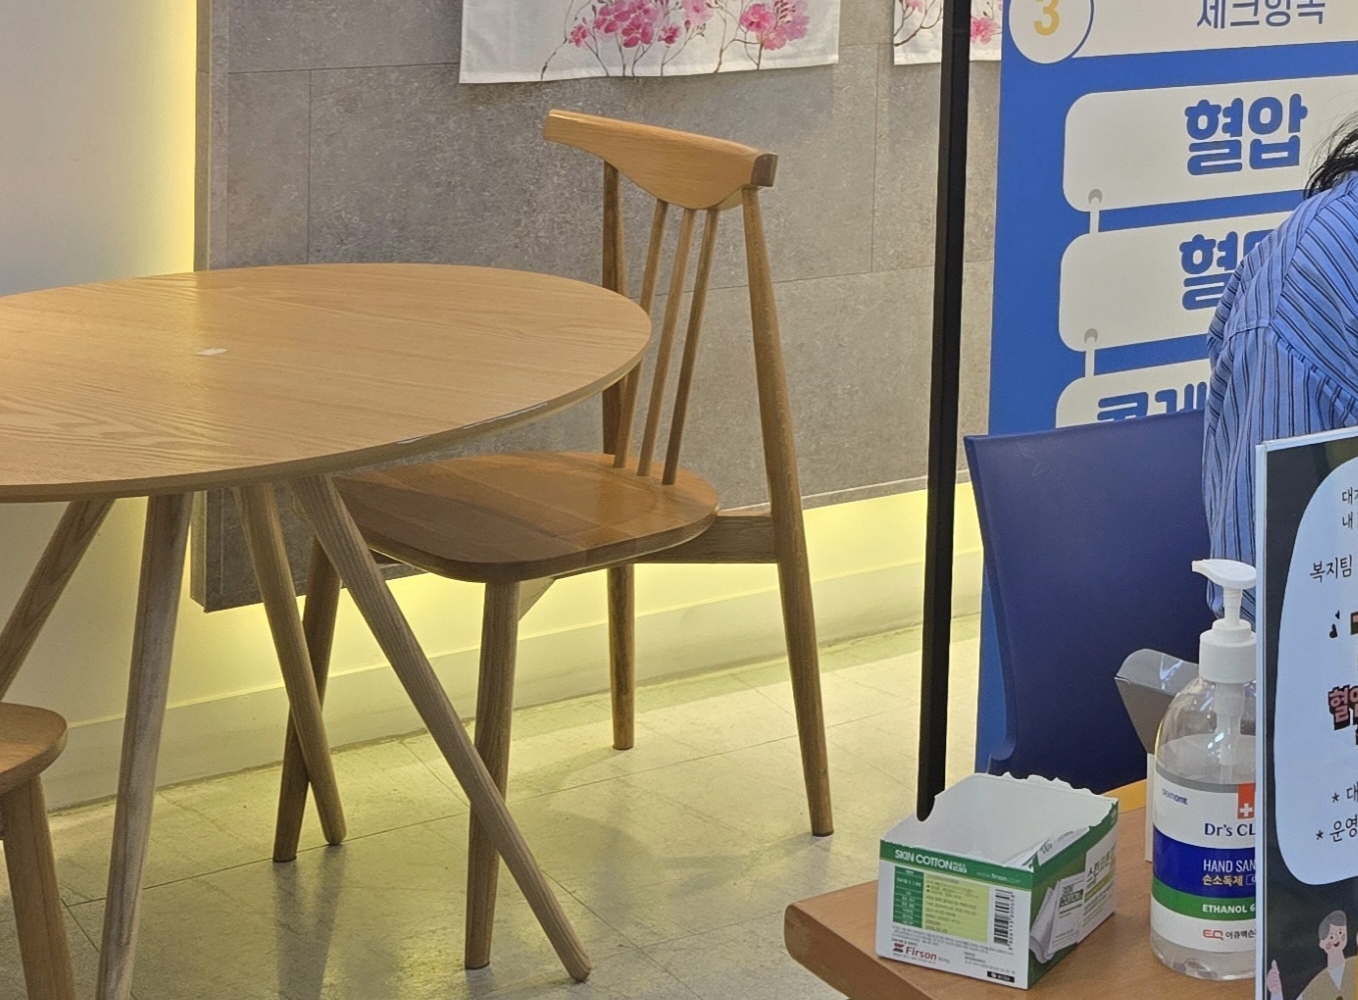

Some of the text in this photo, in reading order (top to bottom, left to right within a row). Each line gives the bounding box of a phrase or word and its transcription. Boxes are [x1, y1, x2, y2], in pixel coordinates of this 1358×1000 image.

[1184, 93, 1308, 176] 혈압
[1179, 228, 1277, 311] 혈
[1342, 511, 1353, 529] 내
[1309, 554, 1353, 583] 복지팀
[1204, 823, 1232, 836] Dr's
[895, 849, 914, 861] SKIN
[916, 853, 953, 870] COTTON
[1203, 859, 1233, 873] HAND
[1202, 875, 1243, 887] 손소독제
[1202, 904, 1247, 913] ETHANOL
[906, 946, 937, 960] Firson
